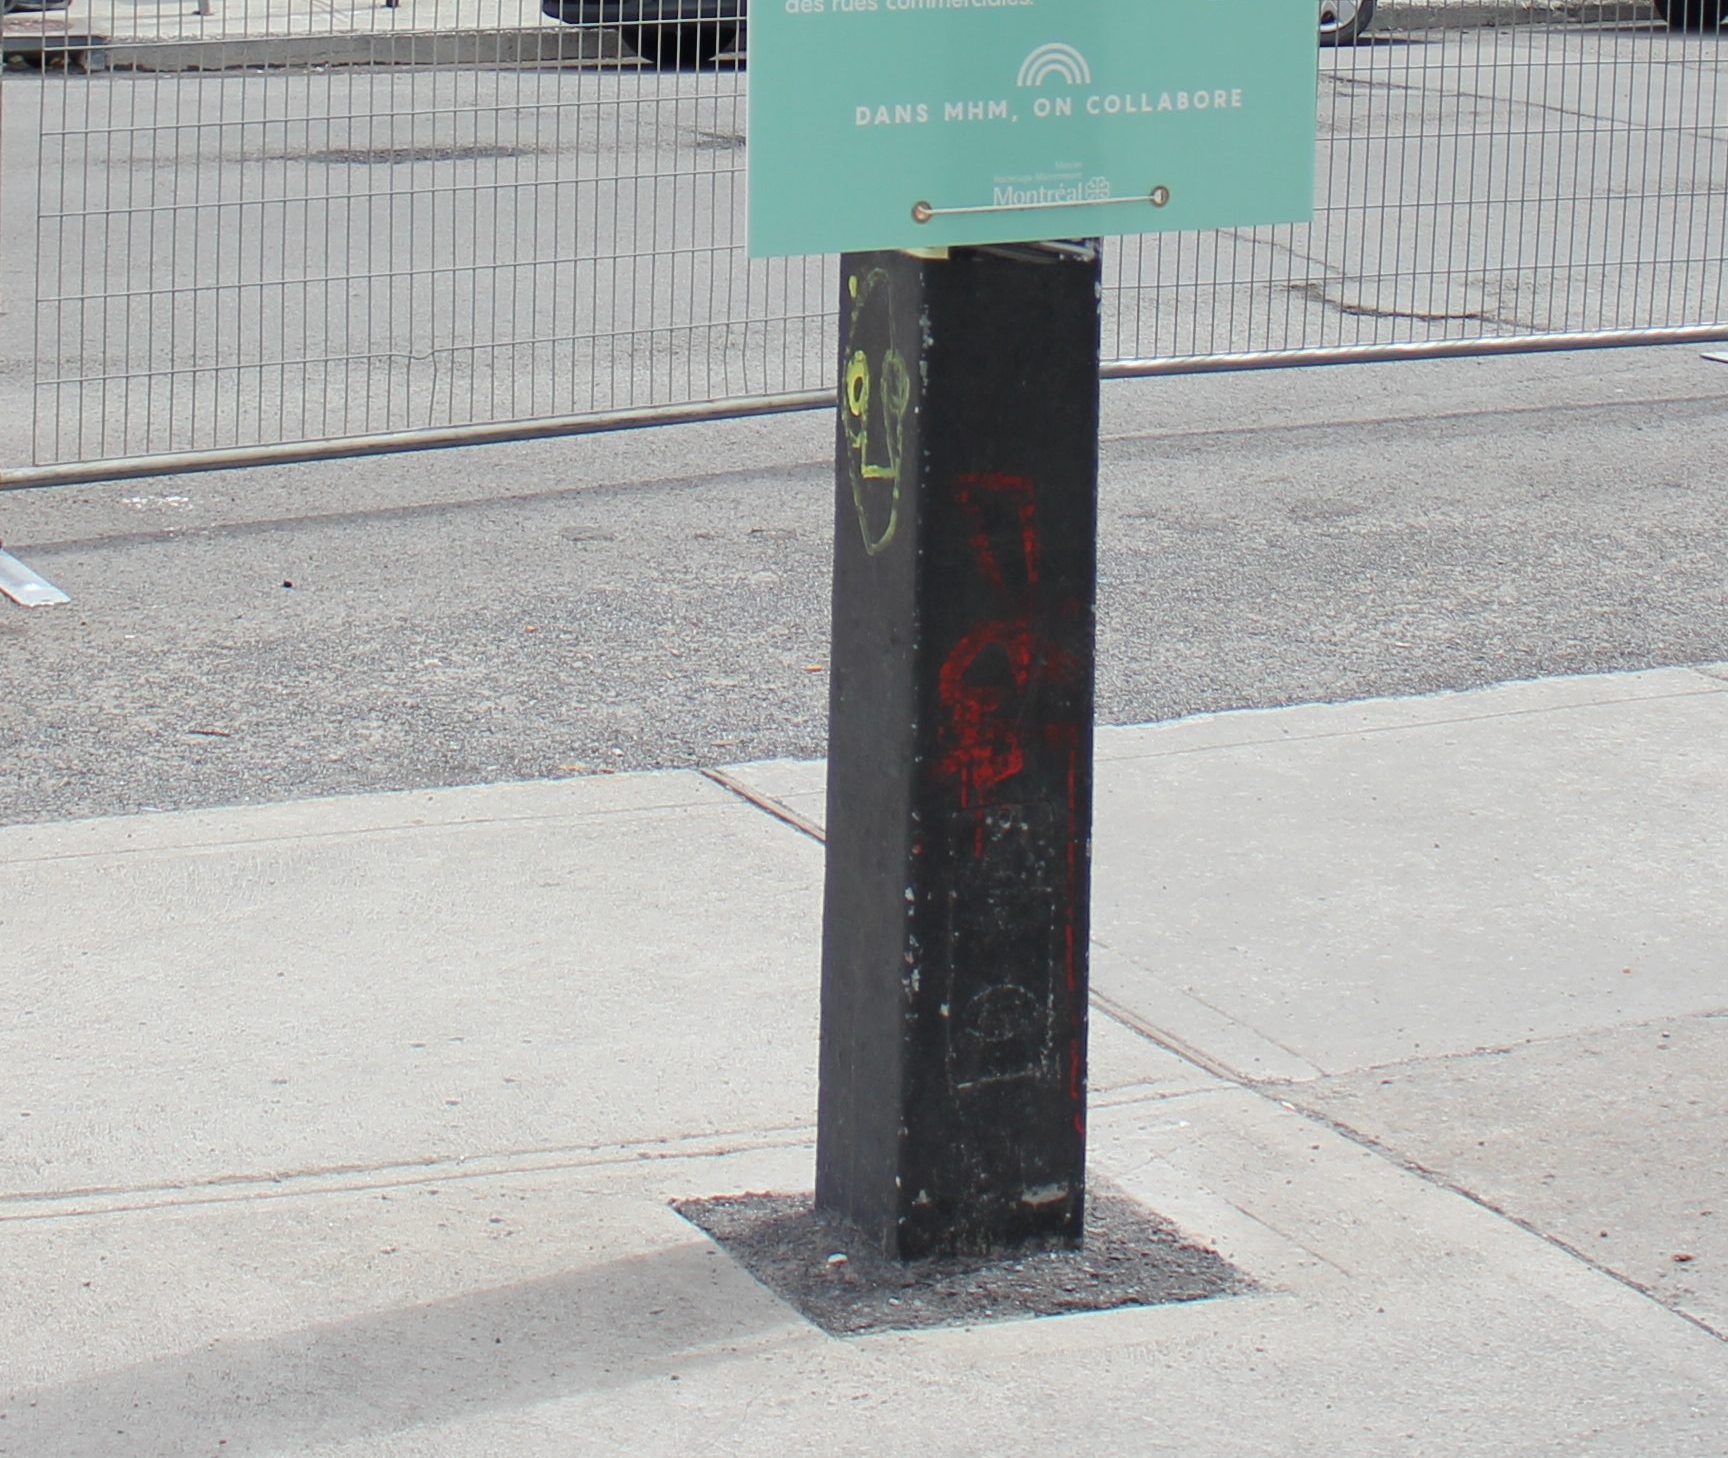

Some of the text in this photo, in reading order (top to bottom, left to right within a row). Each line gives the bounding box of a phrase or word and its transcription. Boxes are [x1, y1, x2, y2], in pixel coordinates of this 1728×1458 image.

[854, 88, 1243, 126] DANS MHM, ON COLLABORE
[992, 182, 1083, 207] Montréal
